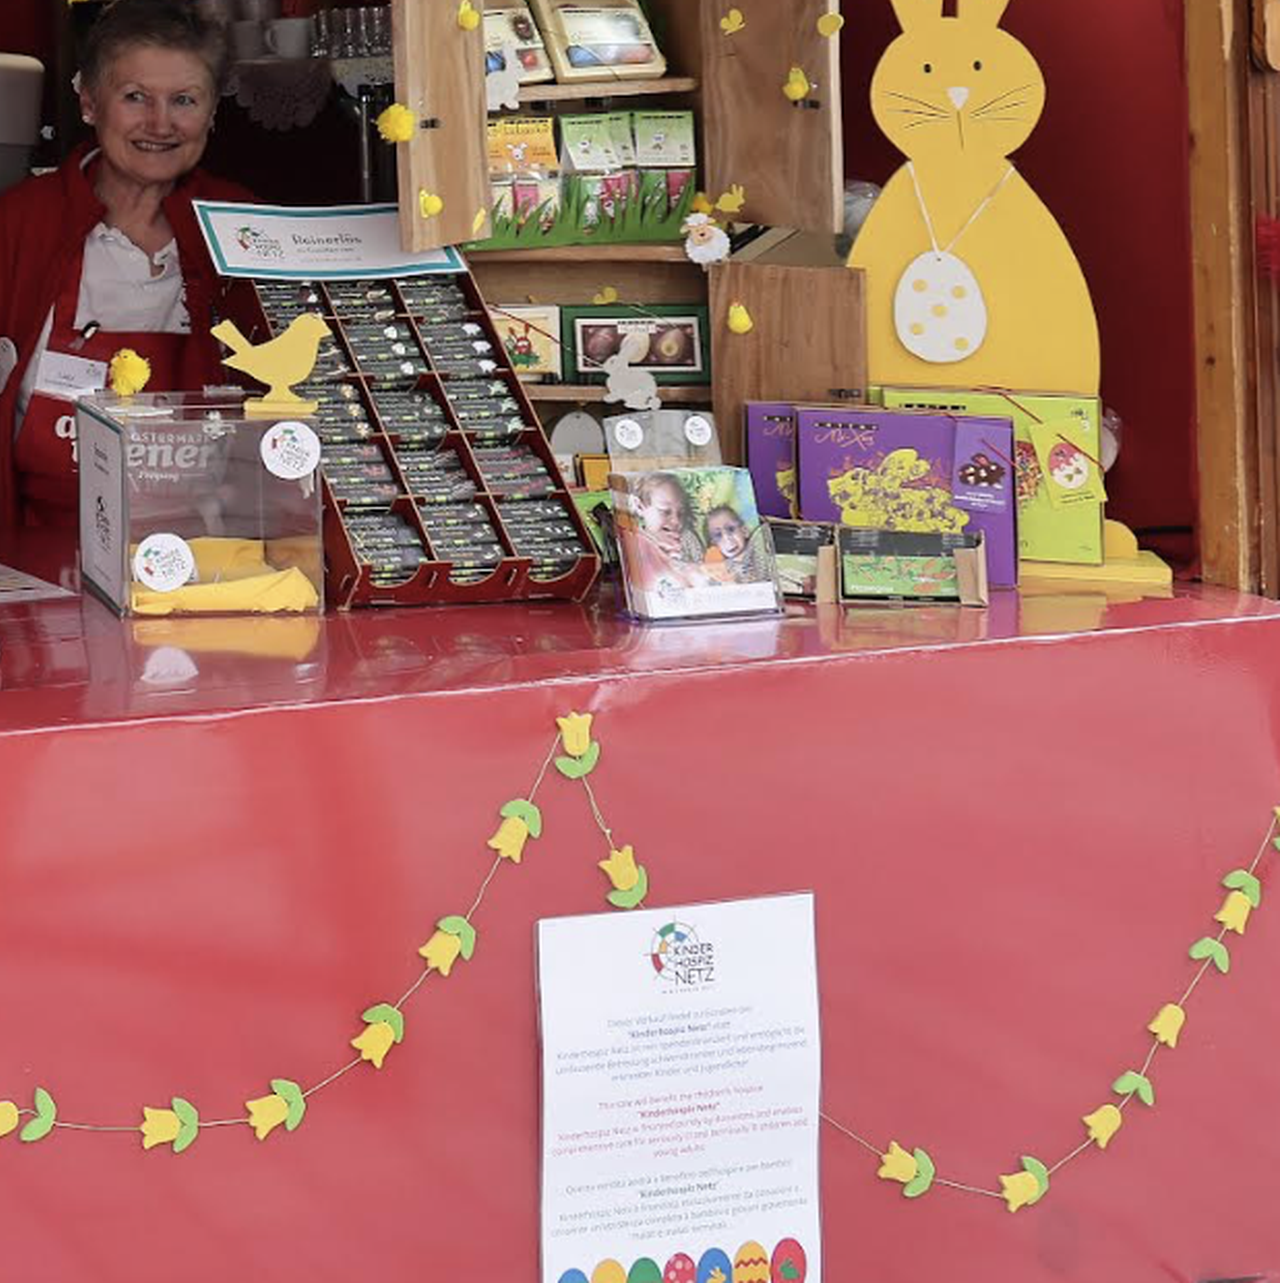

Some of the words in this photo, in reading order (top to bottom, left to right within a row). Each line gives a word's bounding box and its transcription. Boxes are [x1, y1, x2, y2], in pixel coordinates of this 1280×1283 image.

[291, 232, 363, 246] Reinerlös
[674, 943, 714, 957] KINDER
[674, 955, 715, 968] HOSPIZ
[674, 967, 715, 986] NETZ
